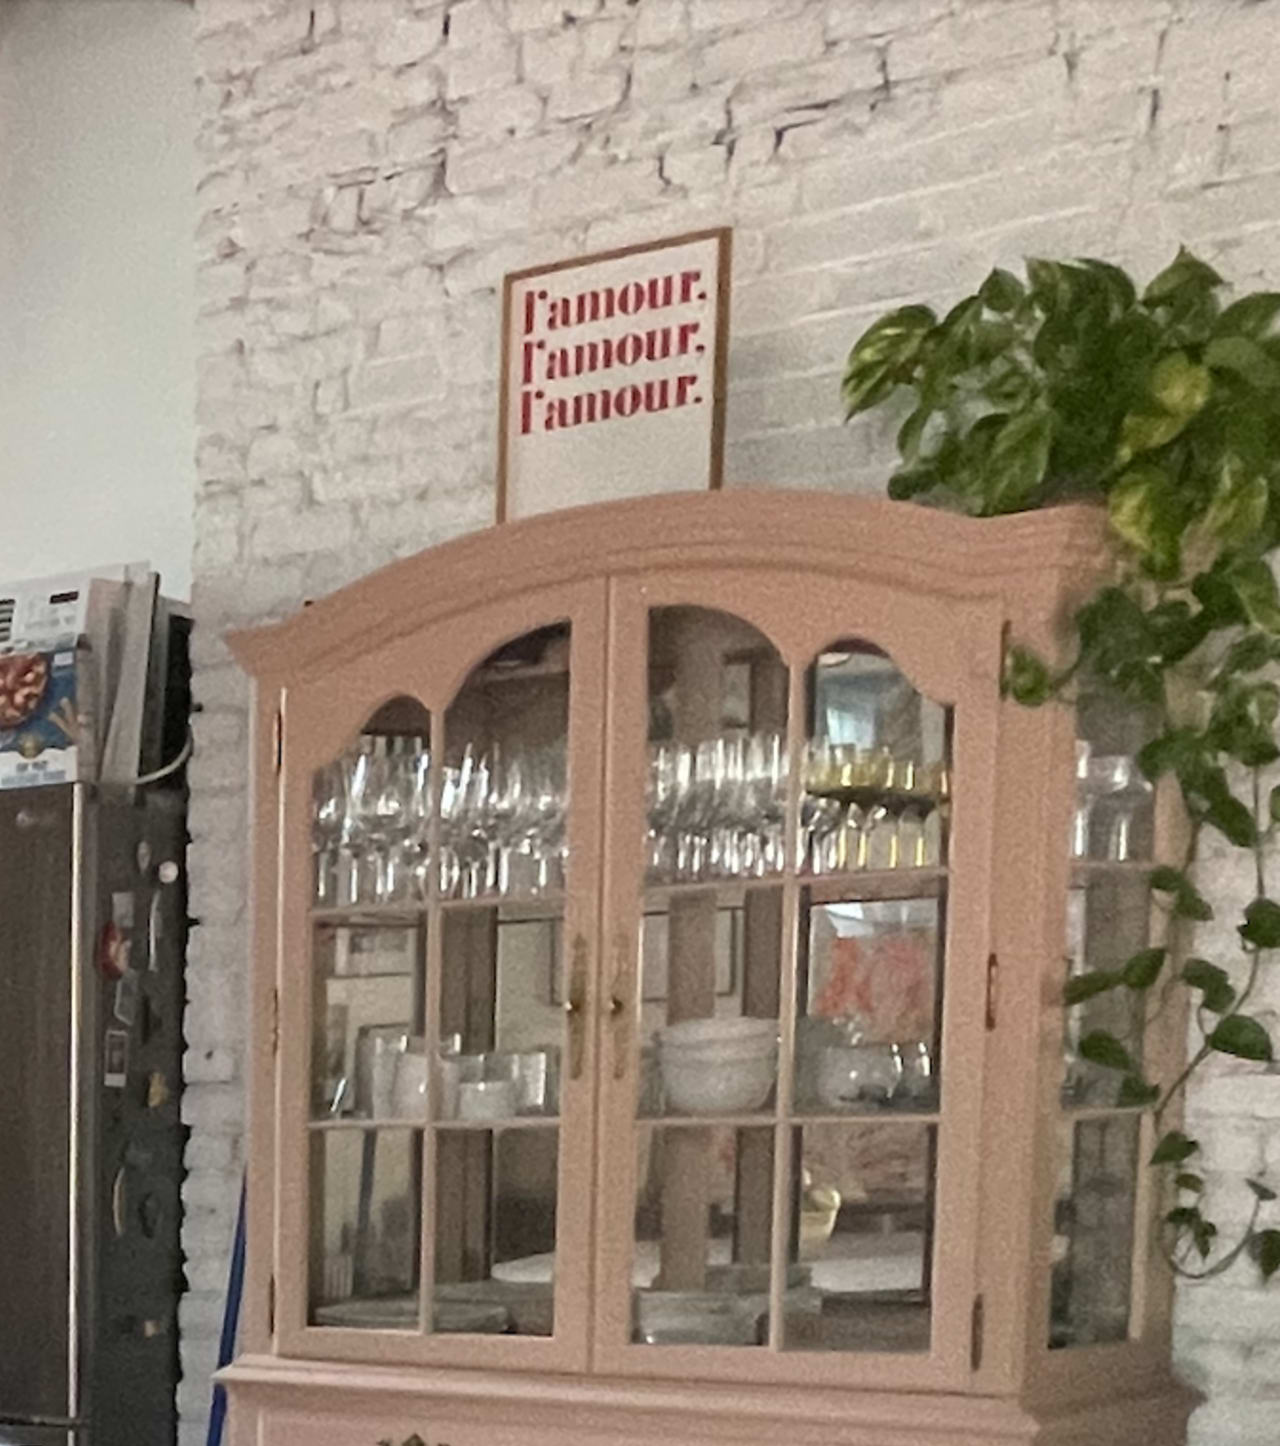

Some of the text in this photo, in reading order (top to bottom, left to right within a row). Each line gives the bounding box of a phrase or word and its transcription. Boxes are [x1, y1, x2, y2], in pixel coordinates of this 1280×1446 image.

[523, 270, 707, 335] l'amour.
[521, 322, 705, 385] l'amour.
[520, 375, 703, 435] l'amour.
